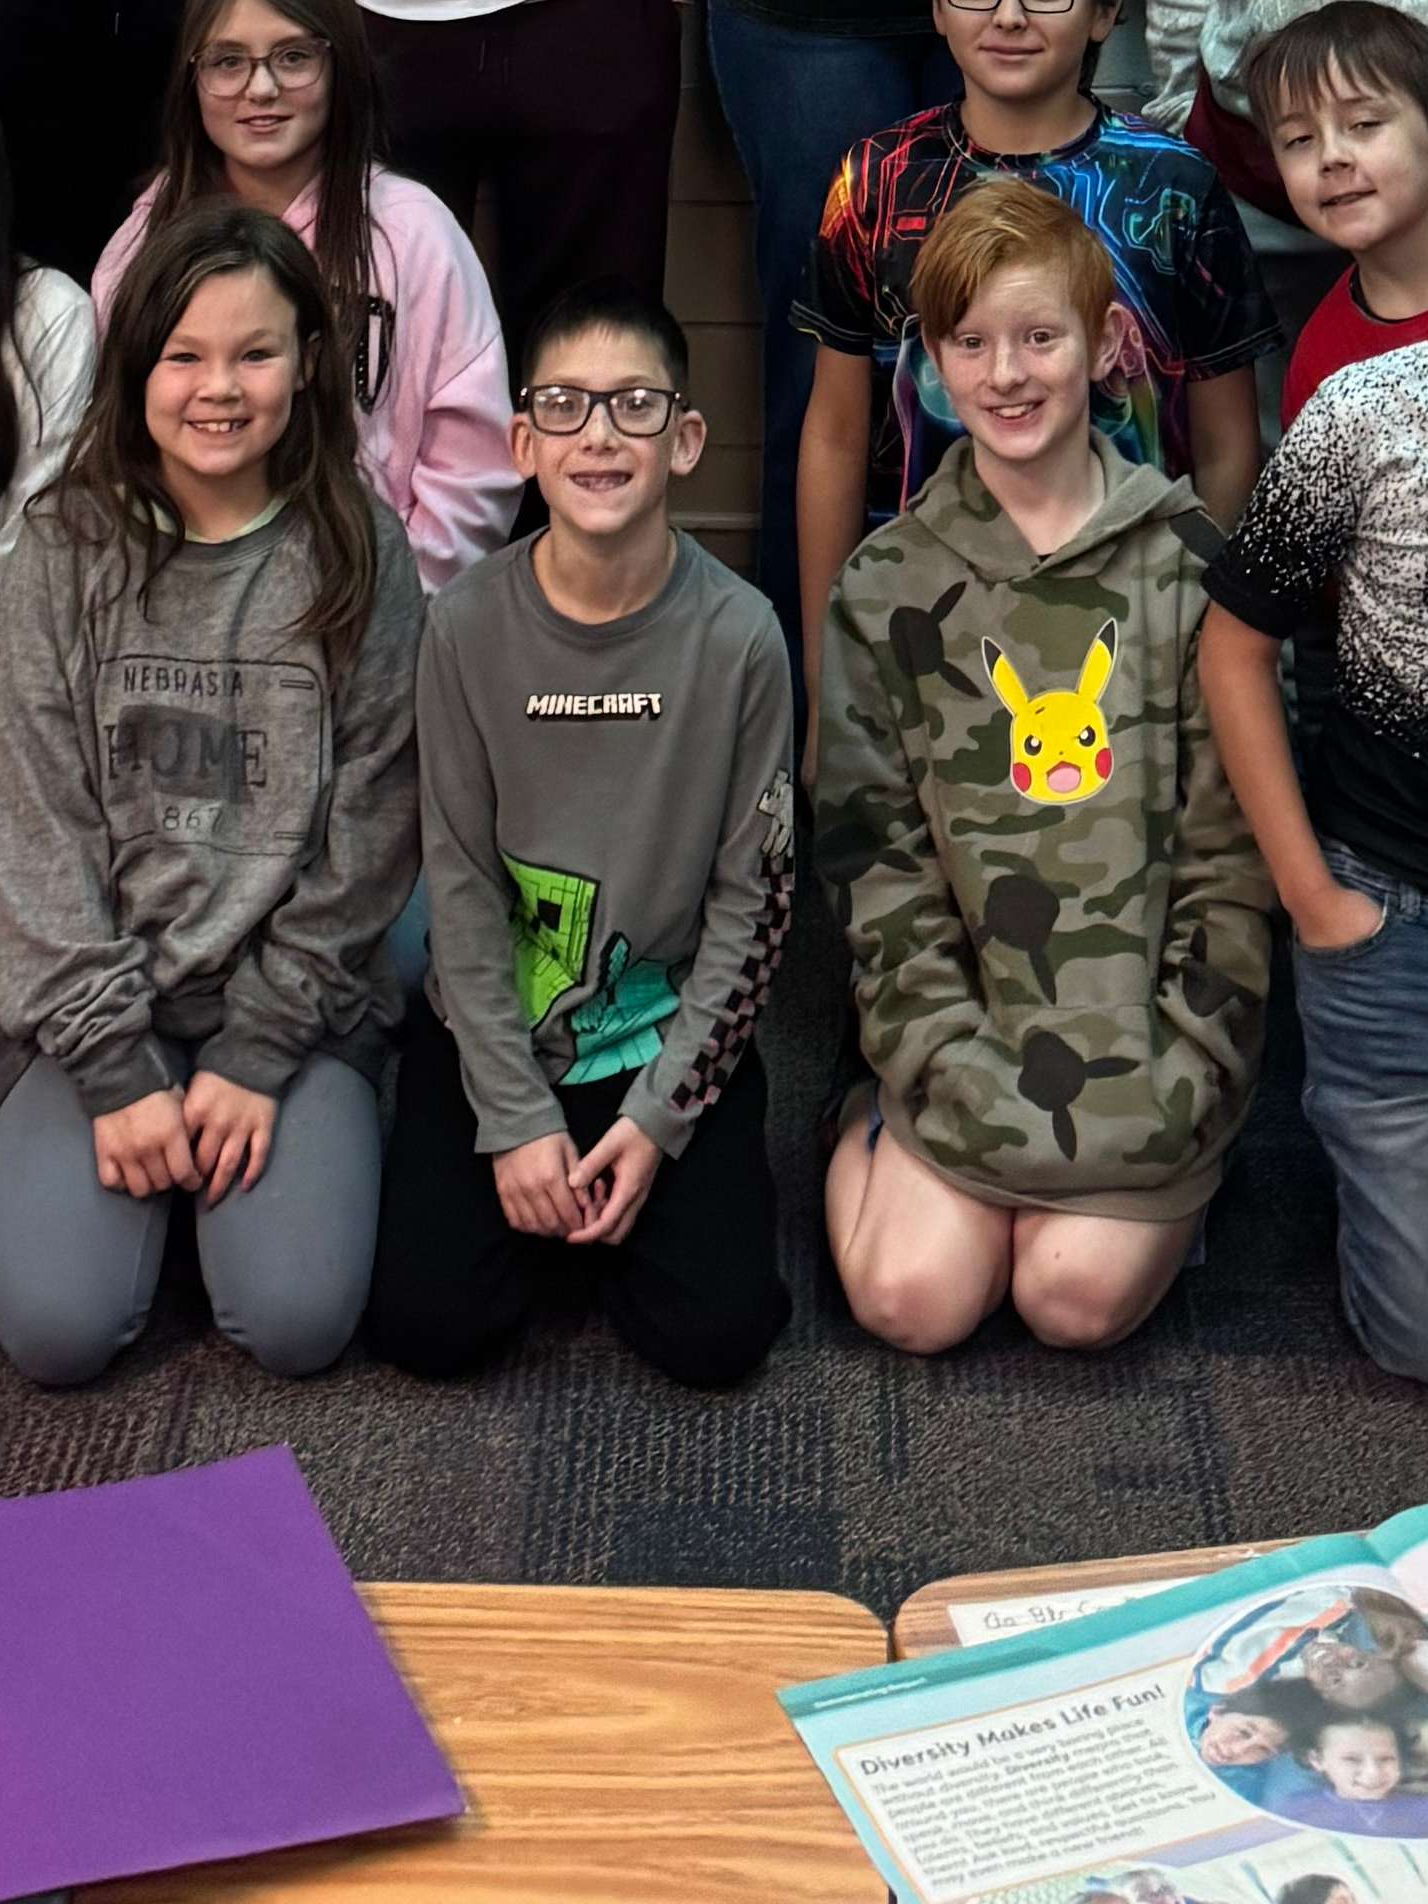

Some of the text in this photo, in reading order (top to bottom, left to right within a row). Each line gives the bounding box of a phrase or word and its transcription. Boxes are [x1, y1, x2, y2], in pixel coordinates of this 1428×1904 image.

[123, 666, 245, 698] NEBRASA
[526, 693, 662, 721] MINECRAFT
[859, 1683, 1168, 1778] Diversity Makes Life Fun!
